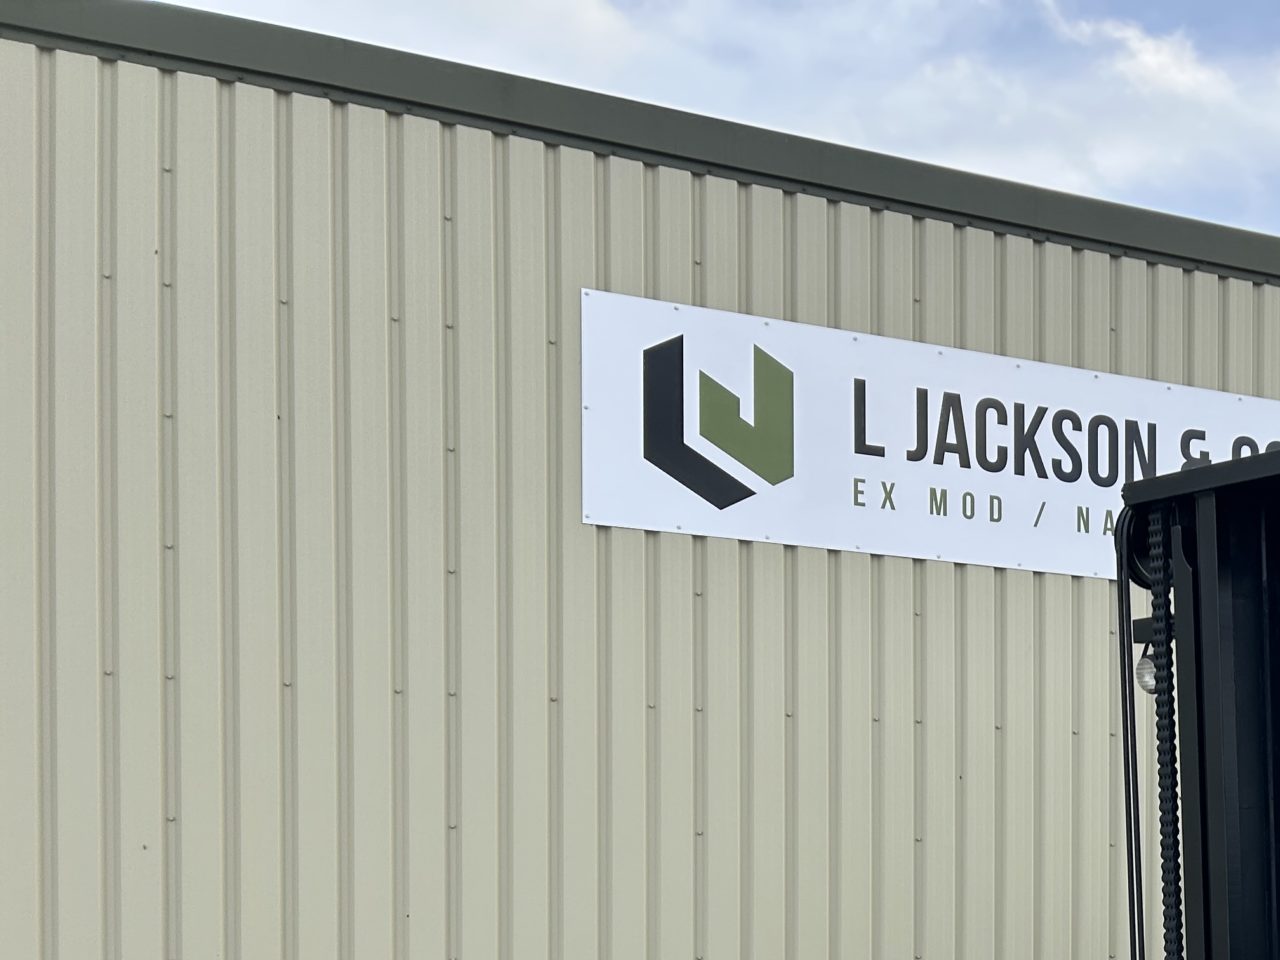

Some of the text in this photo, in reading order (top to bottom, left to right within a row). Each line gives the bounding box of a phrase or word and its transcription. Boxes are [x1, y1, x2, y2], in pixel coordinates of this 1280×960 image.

[853, 377, 886, 458] L
[905, 386, 1158, 489] JACKSON
[853, 477, 896, 511] EX
[929, 486, 1004, 523] MOD
